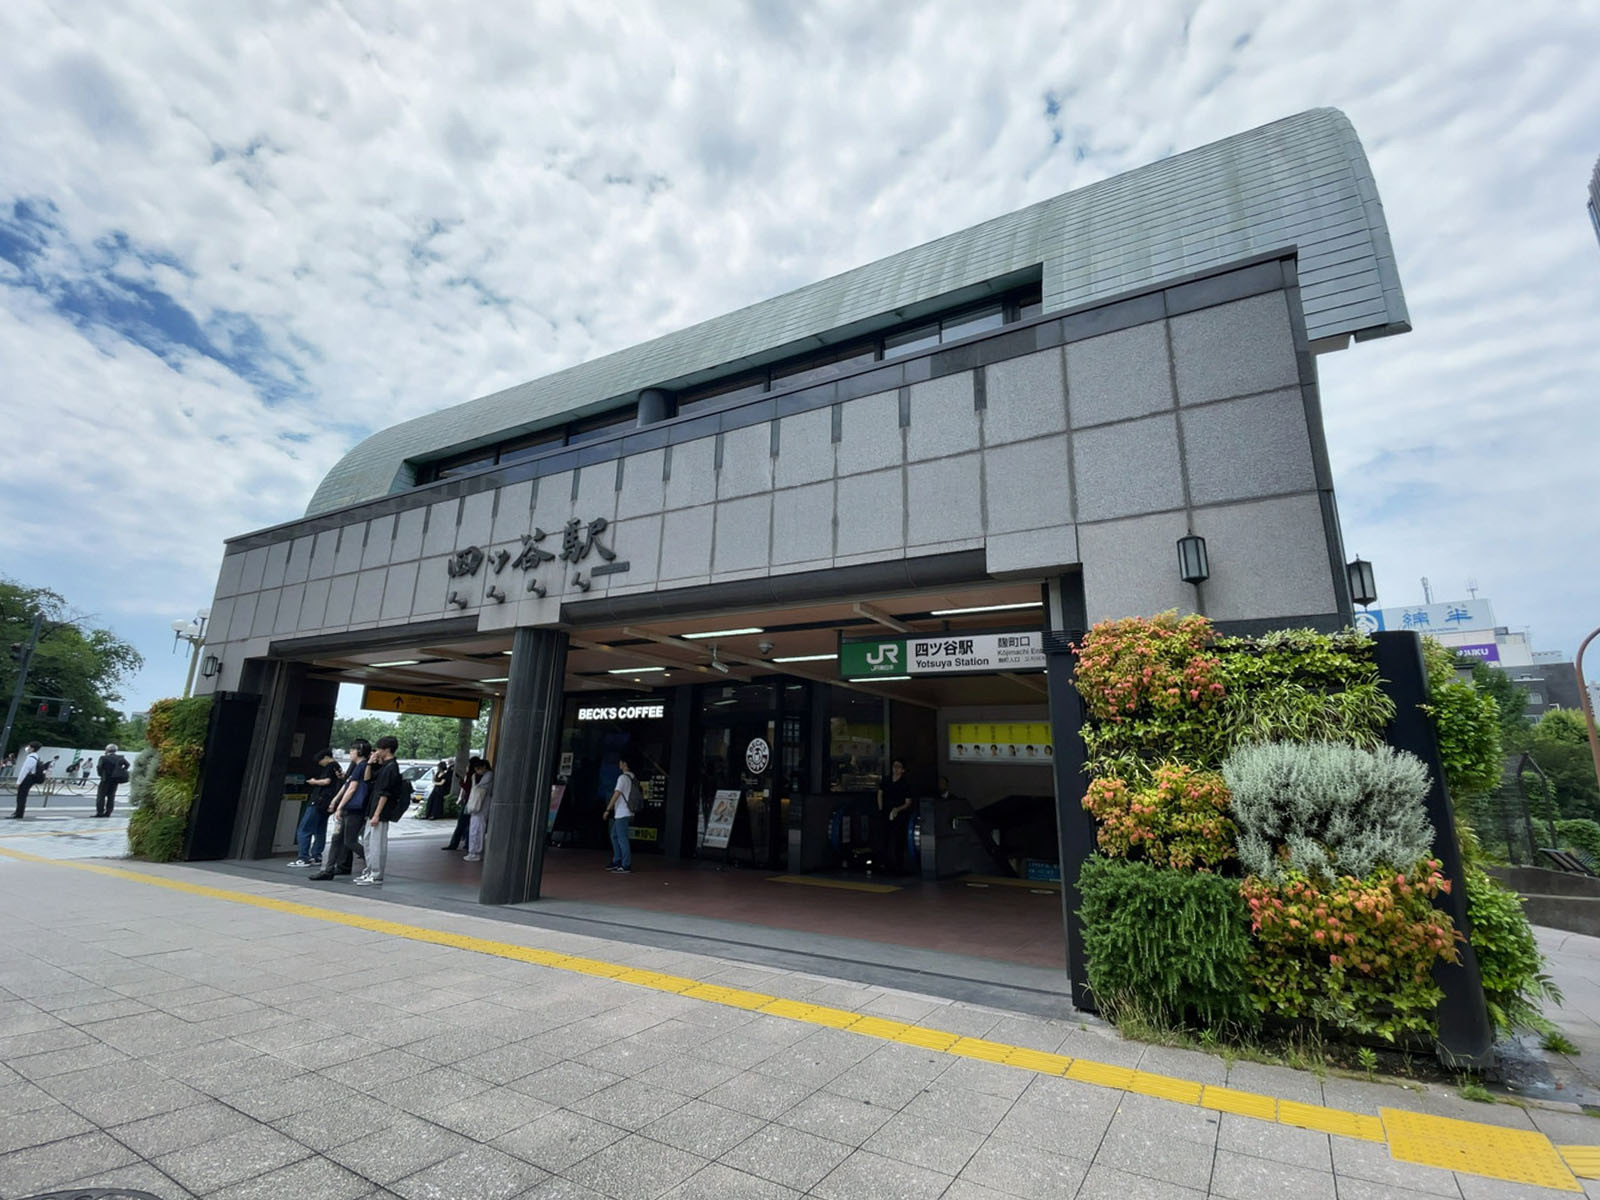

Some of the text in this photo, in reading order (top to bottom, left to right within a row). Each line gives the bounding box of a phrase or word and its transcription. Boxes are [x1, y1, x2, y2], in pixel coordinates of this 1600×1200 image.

[448, 517, 617, 578] 四ツ谷駅
[866, 644, 899, 665] JR
[915, 640, 974, 657] 四ツ谷駅
[916, 657, 989, 670] Yotsuya Station
[578, 705, 664, 720] BECK'S COFFEE
